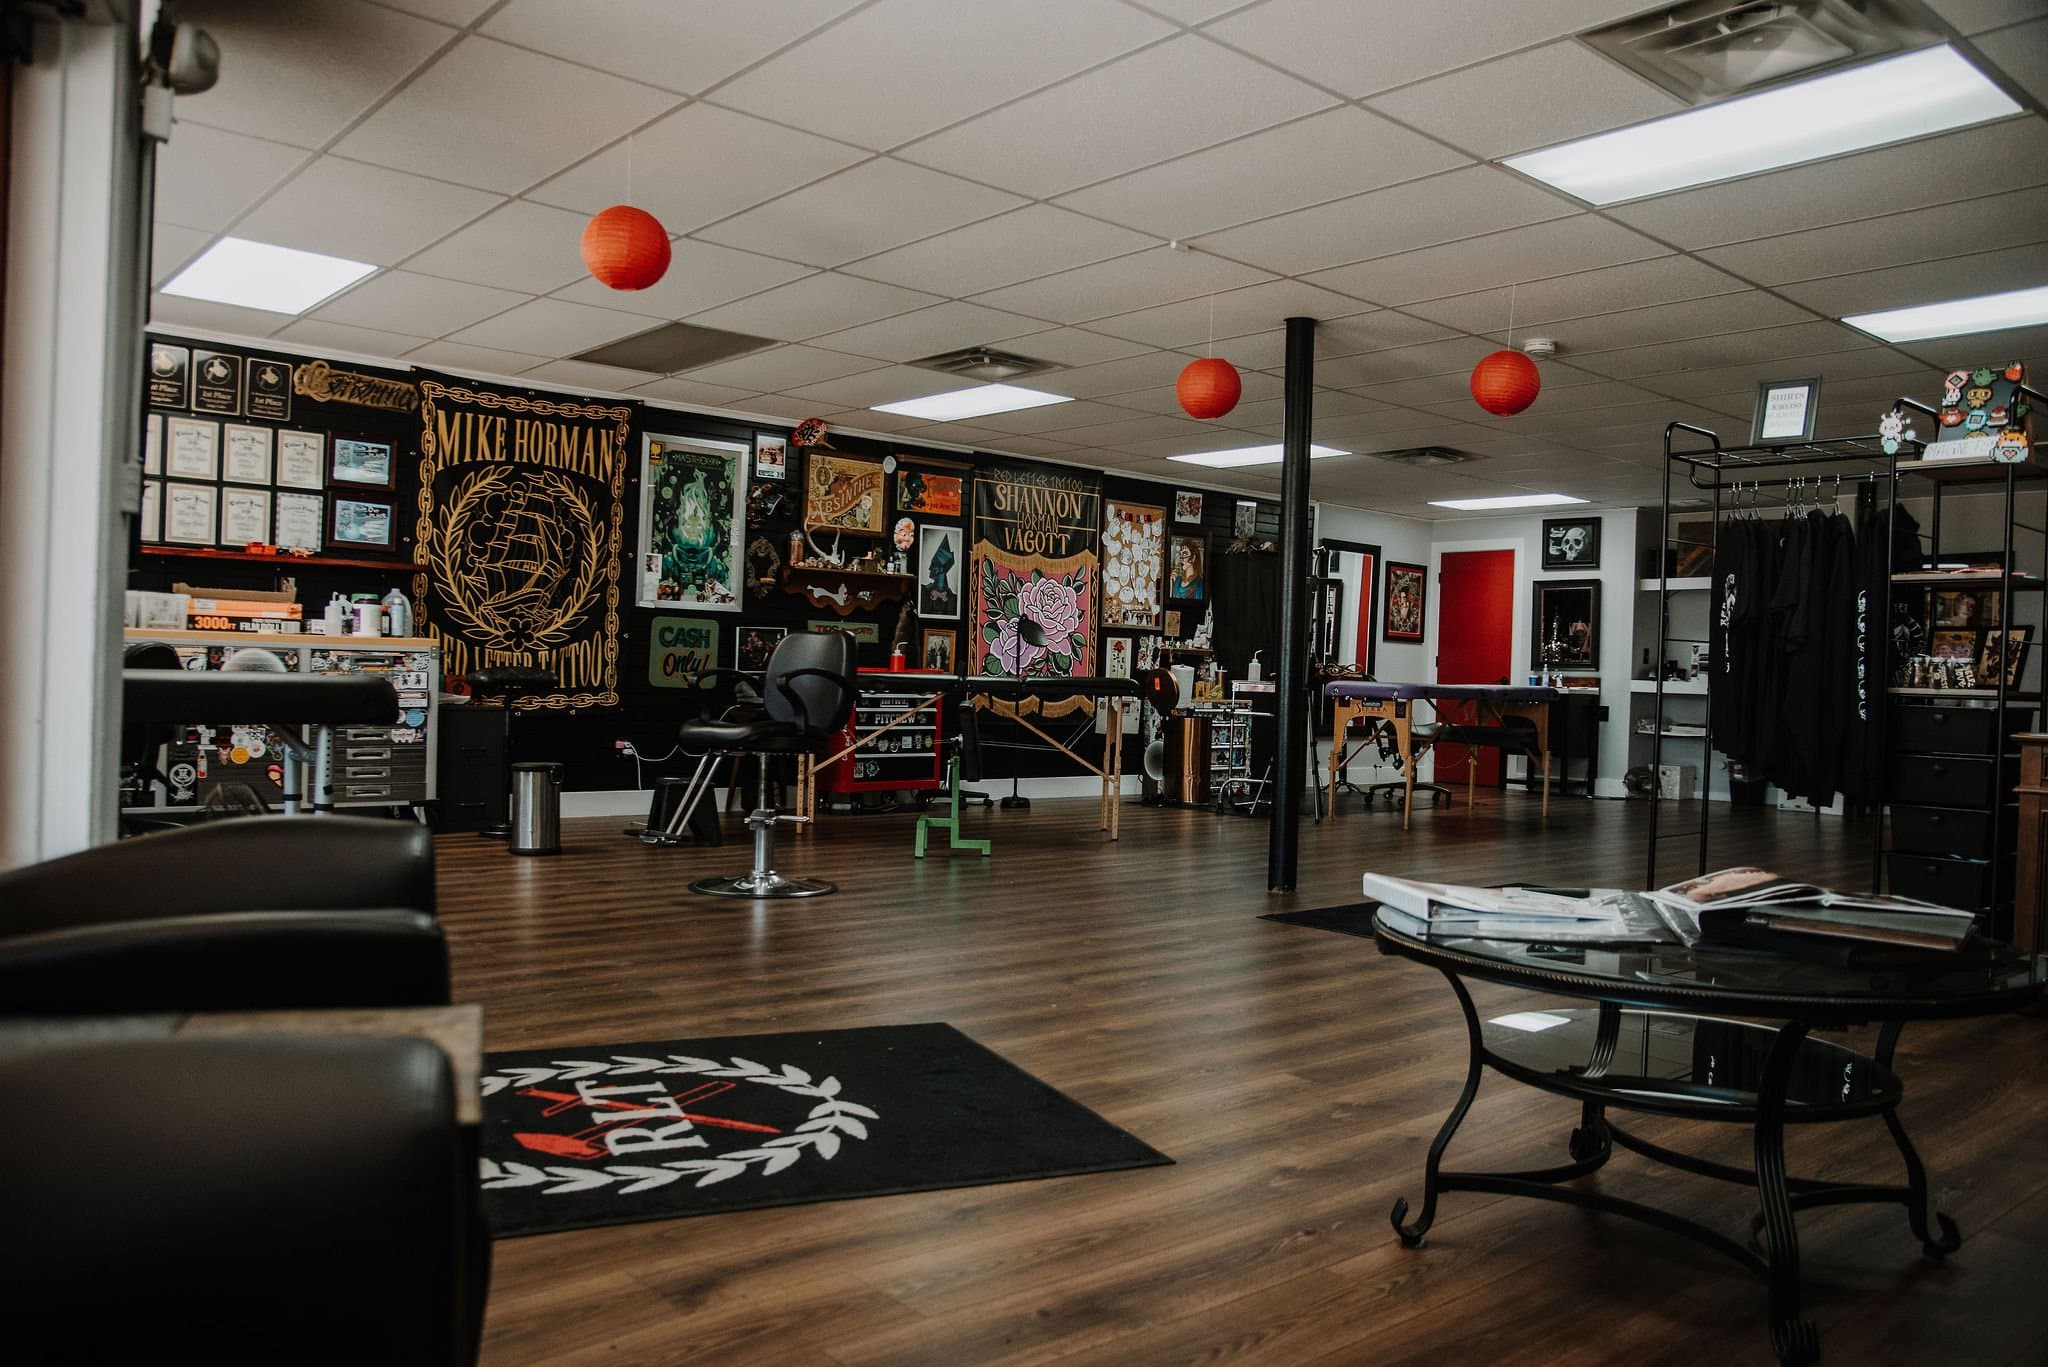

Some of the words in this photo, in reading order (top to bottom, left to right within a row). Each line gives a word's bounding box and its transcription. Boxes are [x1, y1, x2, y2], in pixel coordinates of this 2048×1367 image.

[437, 409, 507, 471] MIKE
[514, 419, 614, 484] HORMAN
[994, 484, 1082, 519] SHANNON
[1017, 511, 1059, 533] HORMAN
[1004, 527, 1071, 555] VAGOTT
[659, 626, 710, 648] CASH
[576, 1079, 710, 1156] RLT
